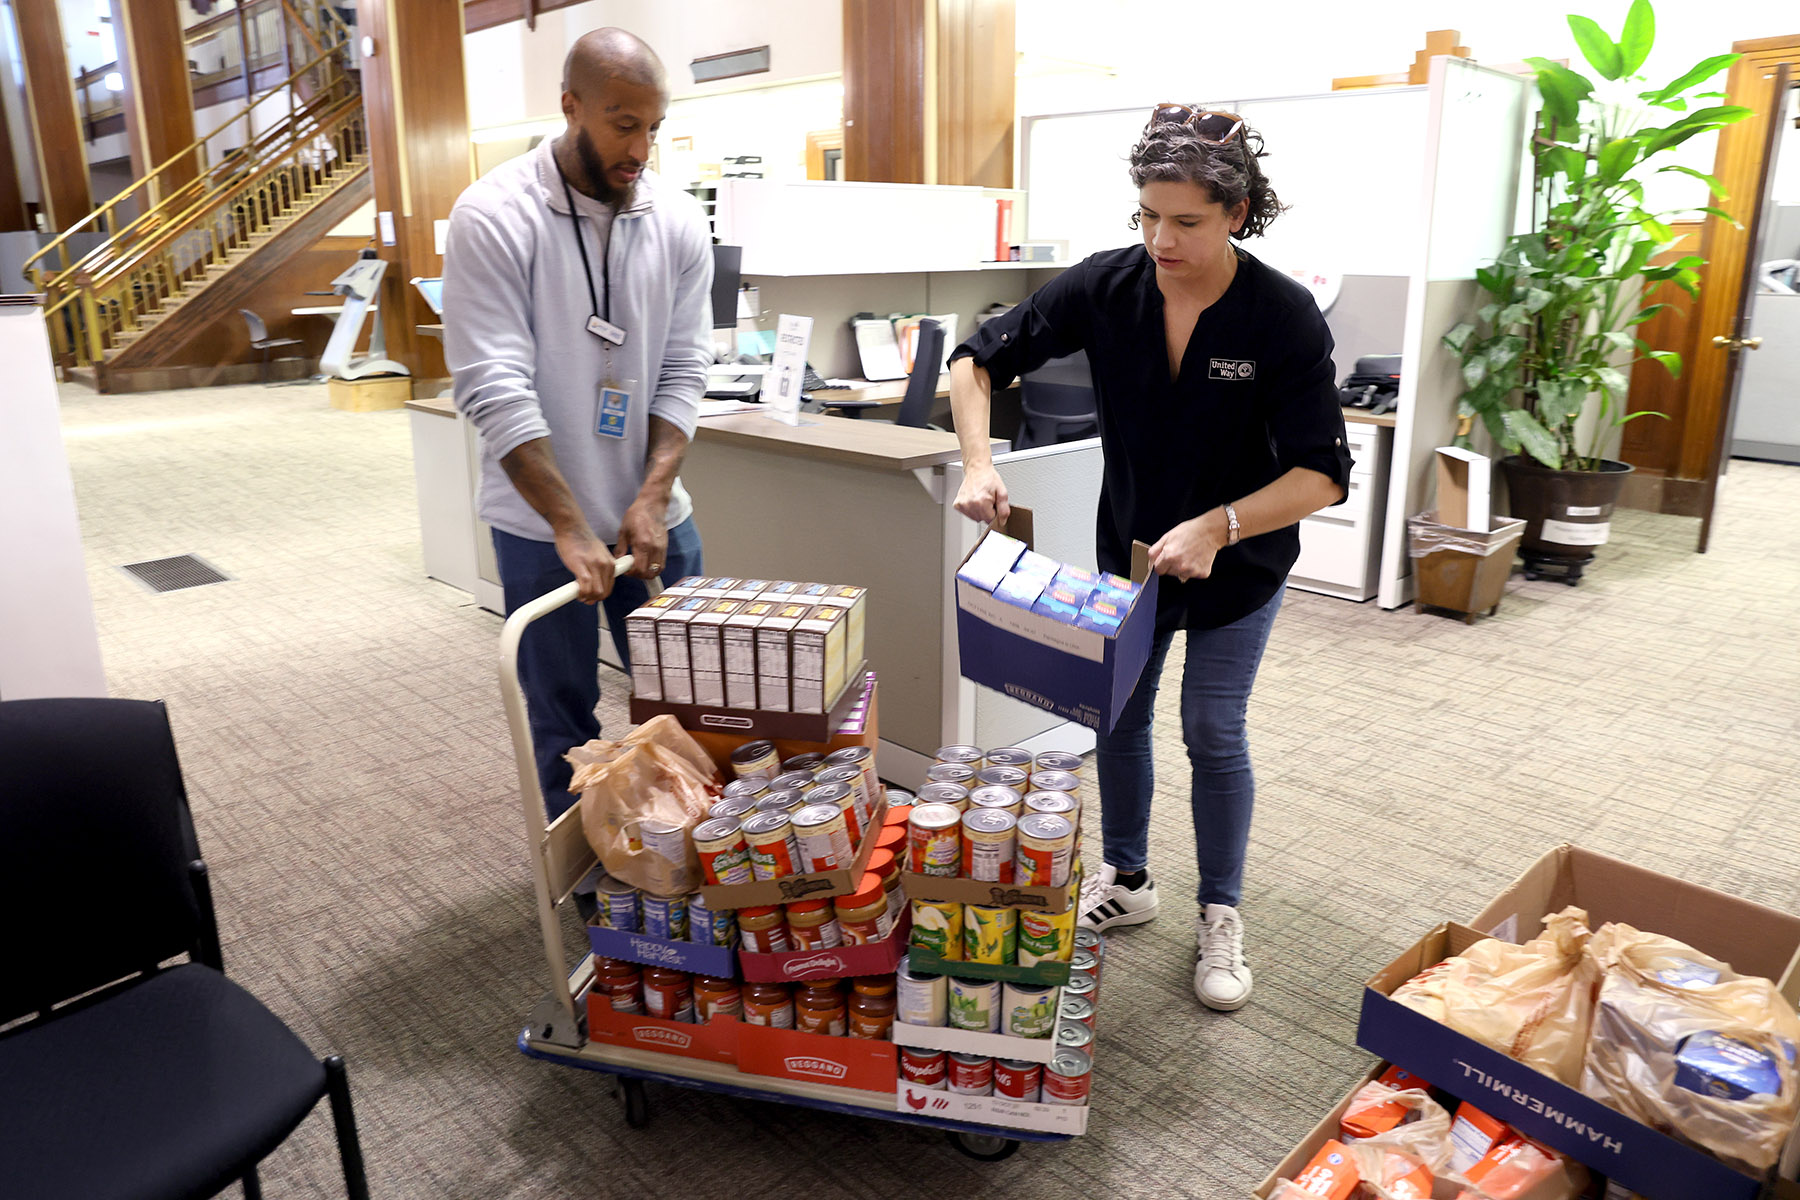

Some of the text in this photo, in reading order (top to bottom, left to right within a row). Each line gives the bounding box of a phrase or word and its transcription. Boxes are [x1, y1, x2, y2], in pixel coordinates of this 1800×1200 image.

[1211, 360, 1236, 370] United
[1220, 369, 1235, 379] Way
[630, 937, 671, 956] Happy
[637, 947, 684, 965] Harvest
[1459, 1061, 1623, 1154] HAMMERMILL
